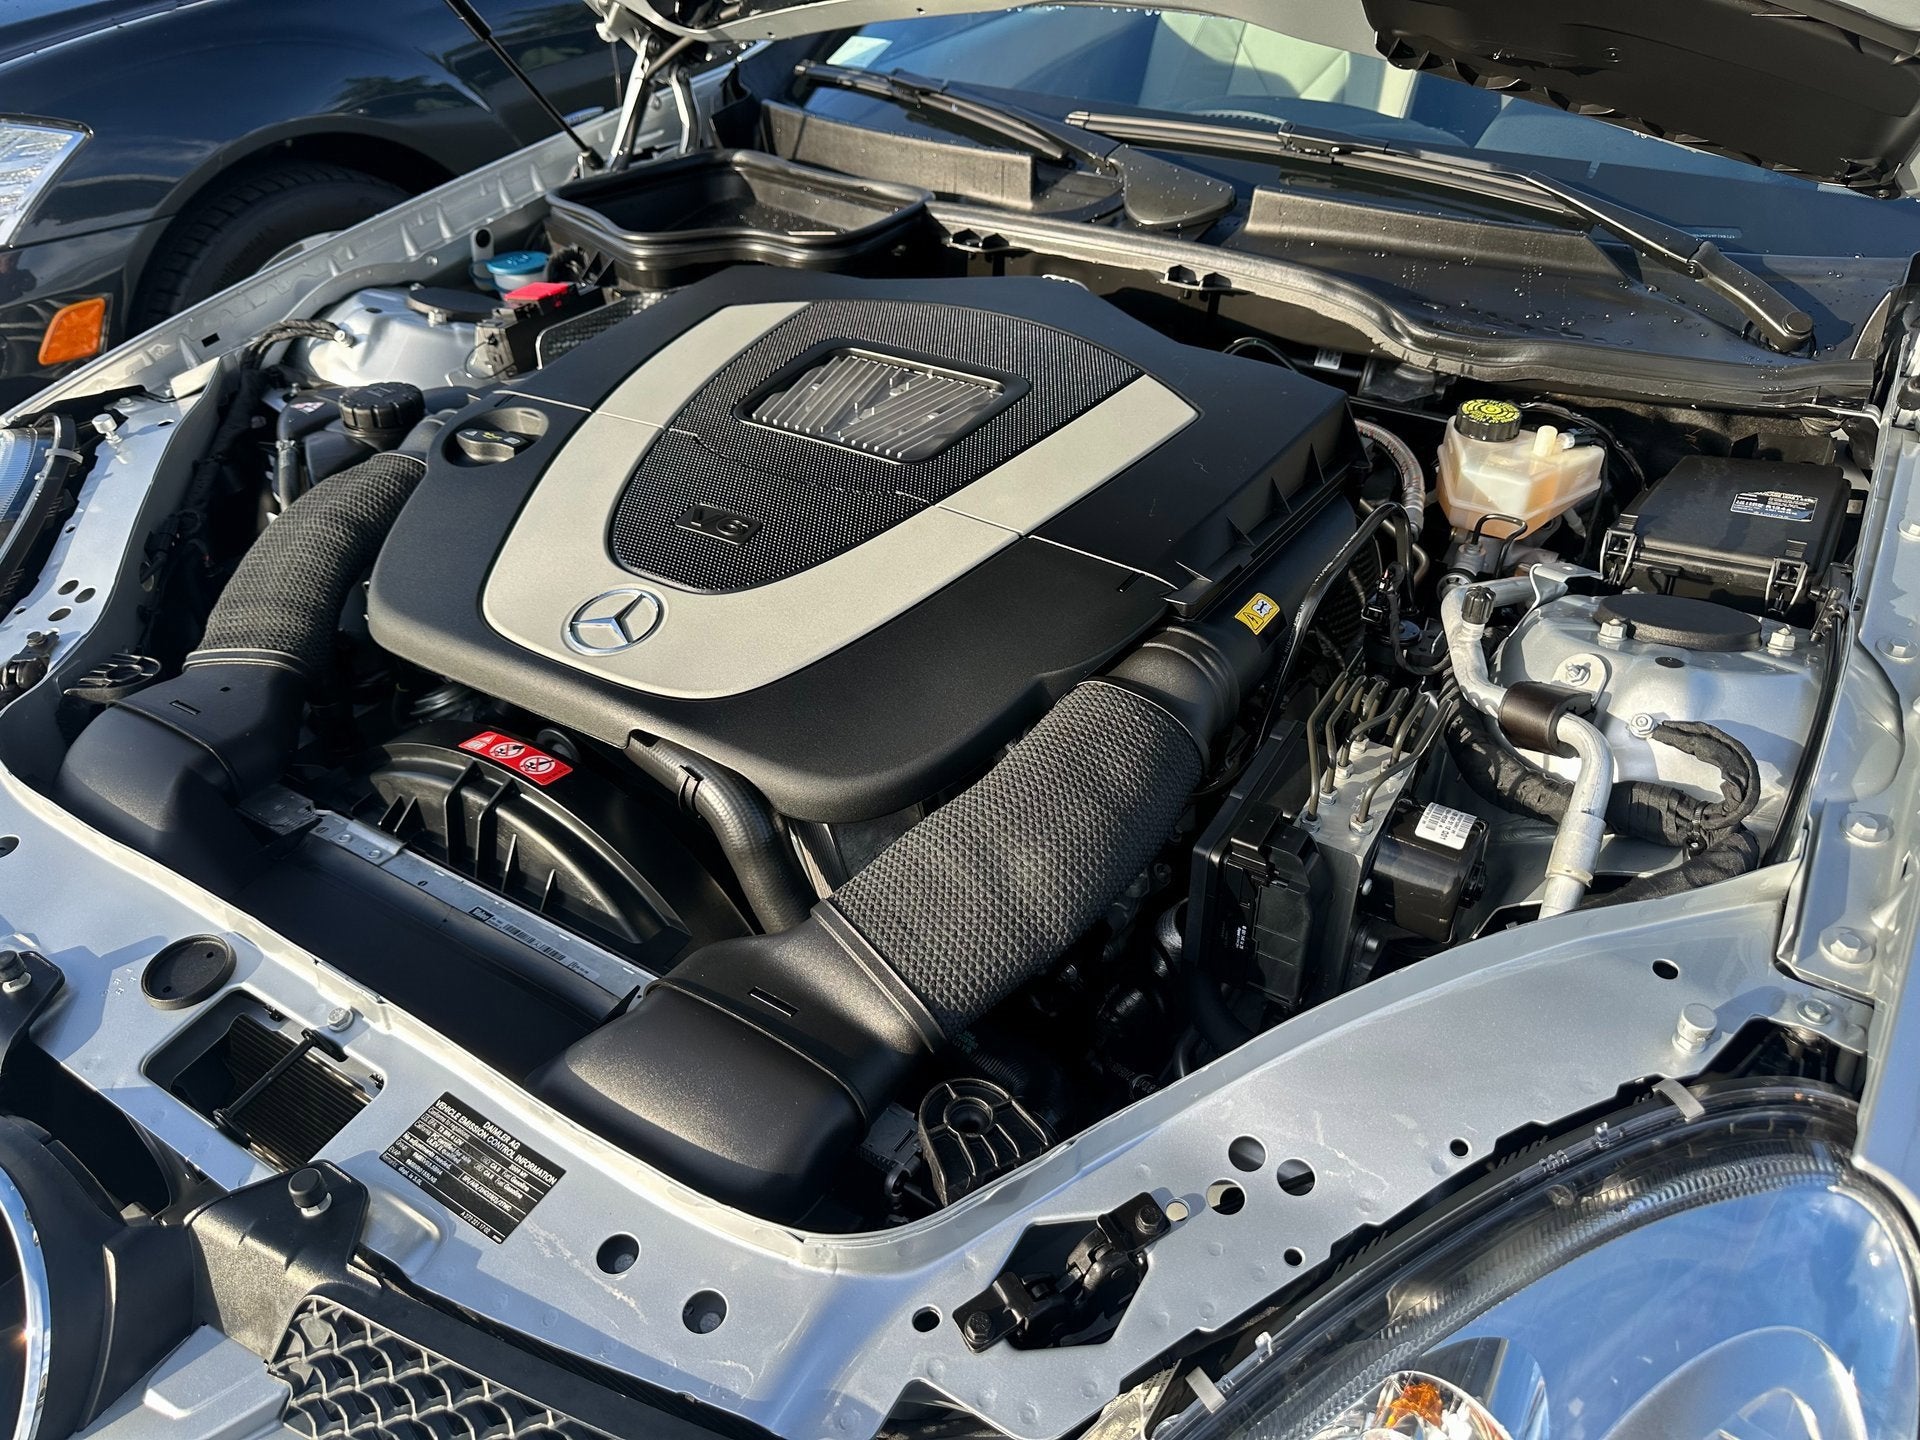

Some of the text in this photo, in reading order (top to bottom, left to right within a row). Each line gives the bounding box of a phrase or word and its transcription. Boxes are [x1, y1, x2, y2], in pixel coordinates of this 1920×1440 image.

[690, 507, 749, 536] V6
[435, 1100, 558, 1186] VEHICLE EMISSION CONTROL INFORMATION
[482, 1121, 522, 1150] DAIMLER AG
[503, 1183, 524, 1200] Gasoline
[510, 1176, 531, 1192] Gasoline
